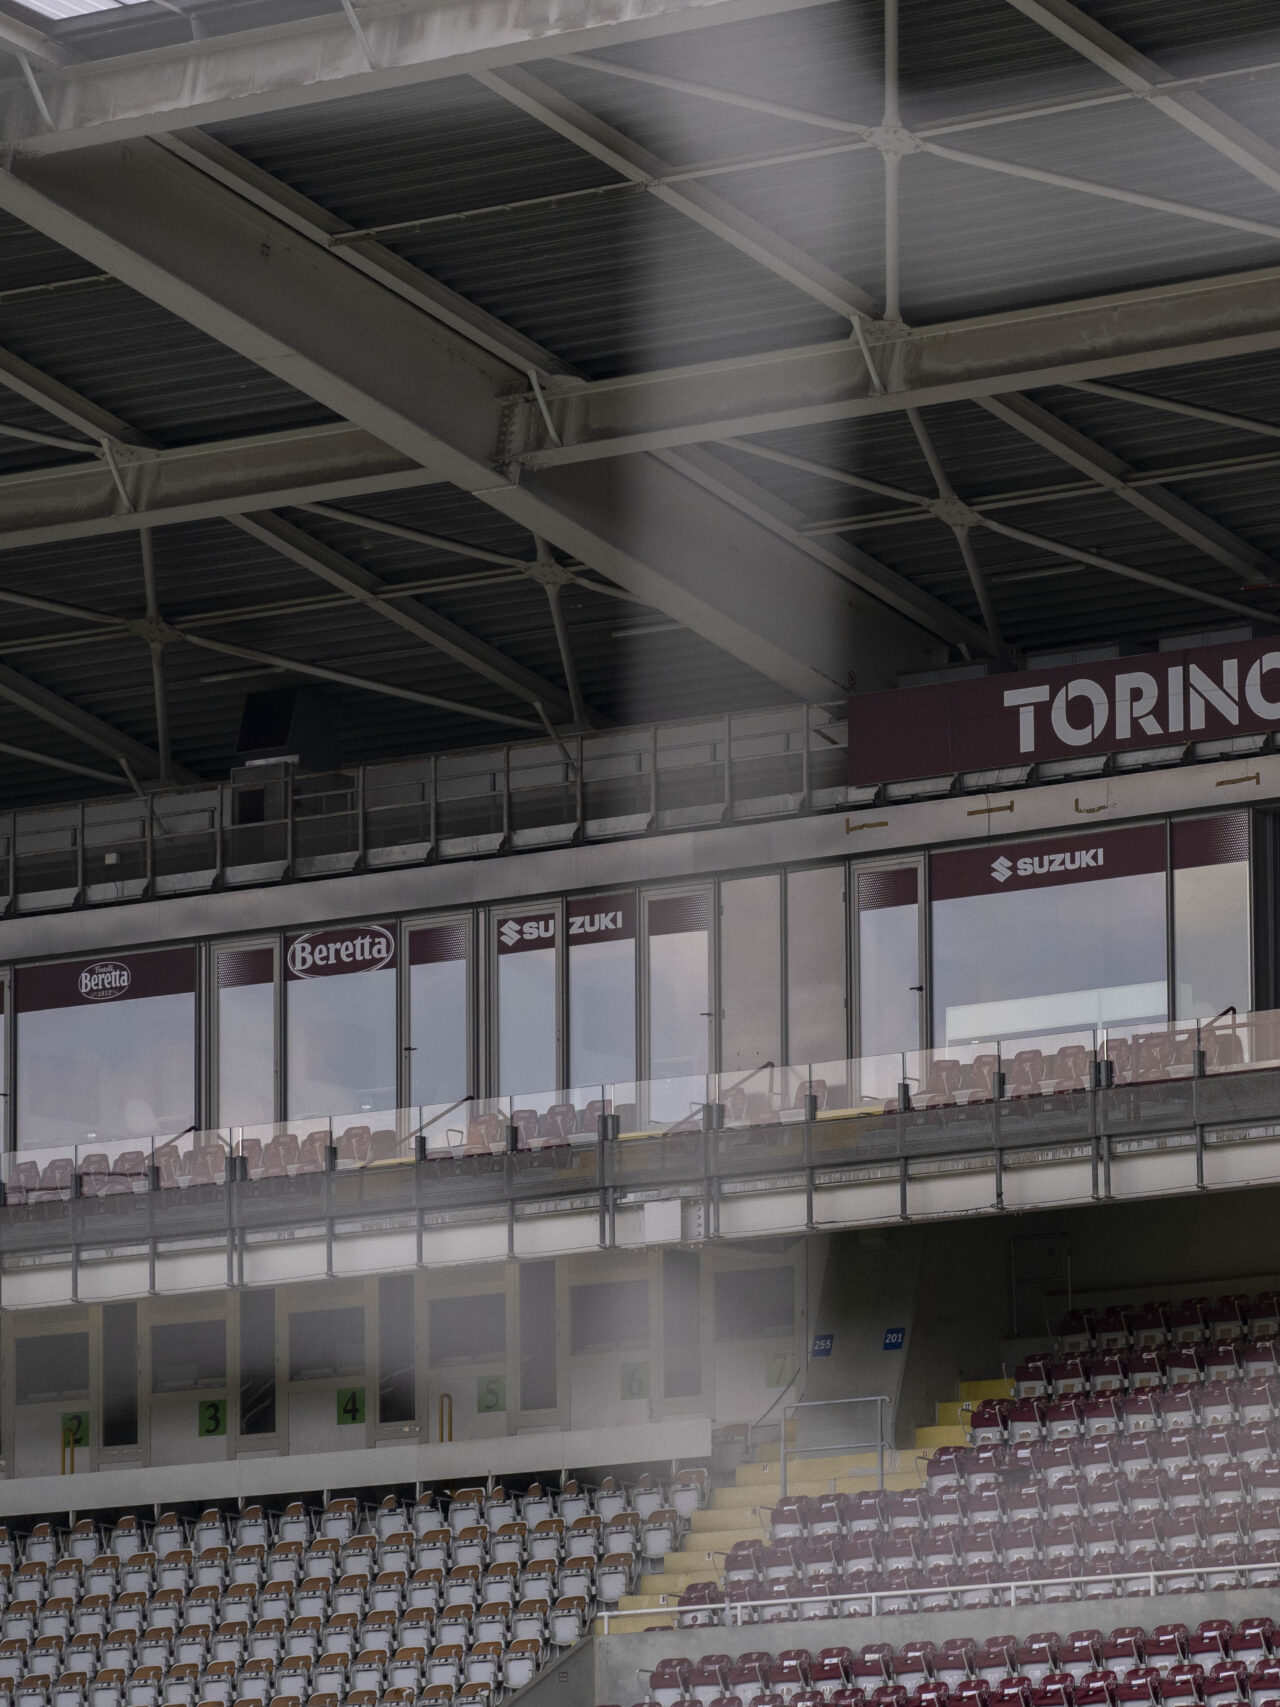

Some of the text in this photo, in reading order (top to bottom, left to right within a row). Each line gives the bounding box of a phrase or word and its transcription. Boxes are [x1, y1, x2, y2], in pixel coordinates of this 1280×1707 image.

[1016, 847, 1104, 877] SUZUKI
[293, 933, 389, 971] Beretta
[81, 969, 129, 993] Beretta
[814, 1339, 831, 1350] 255
[885, 1333, 902, 1343] 201
[343, 1390, 360, 1421] 4
[484, 1379, 500, 1410] 5
[68, 1414, 84, 1445] 2
[204, 1404, 221, 1434] 3
